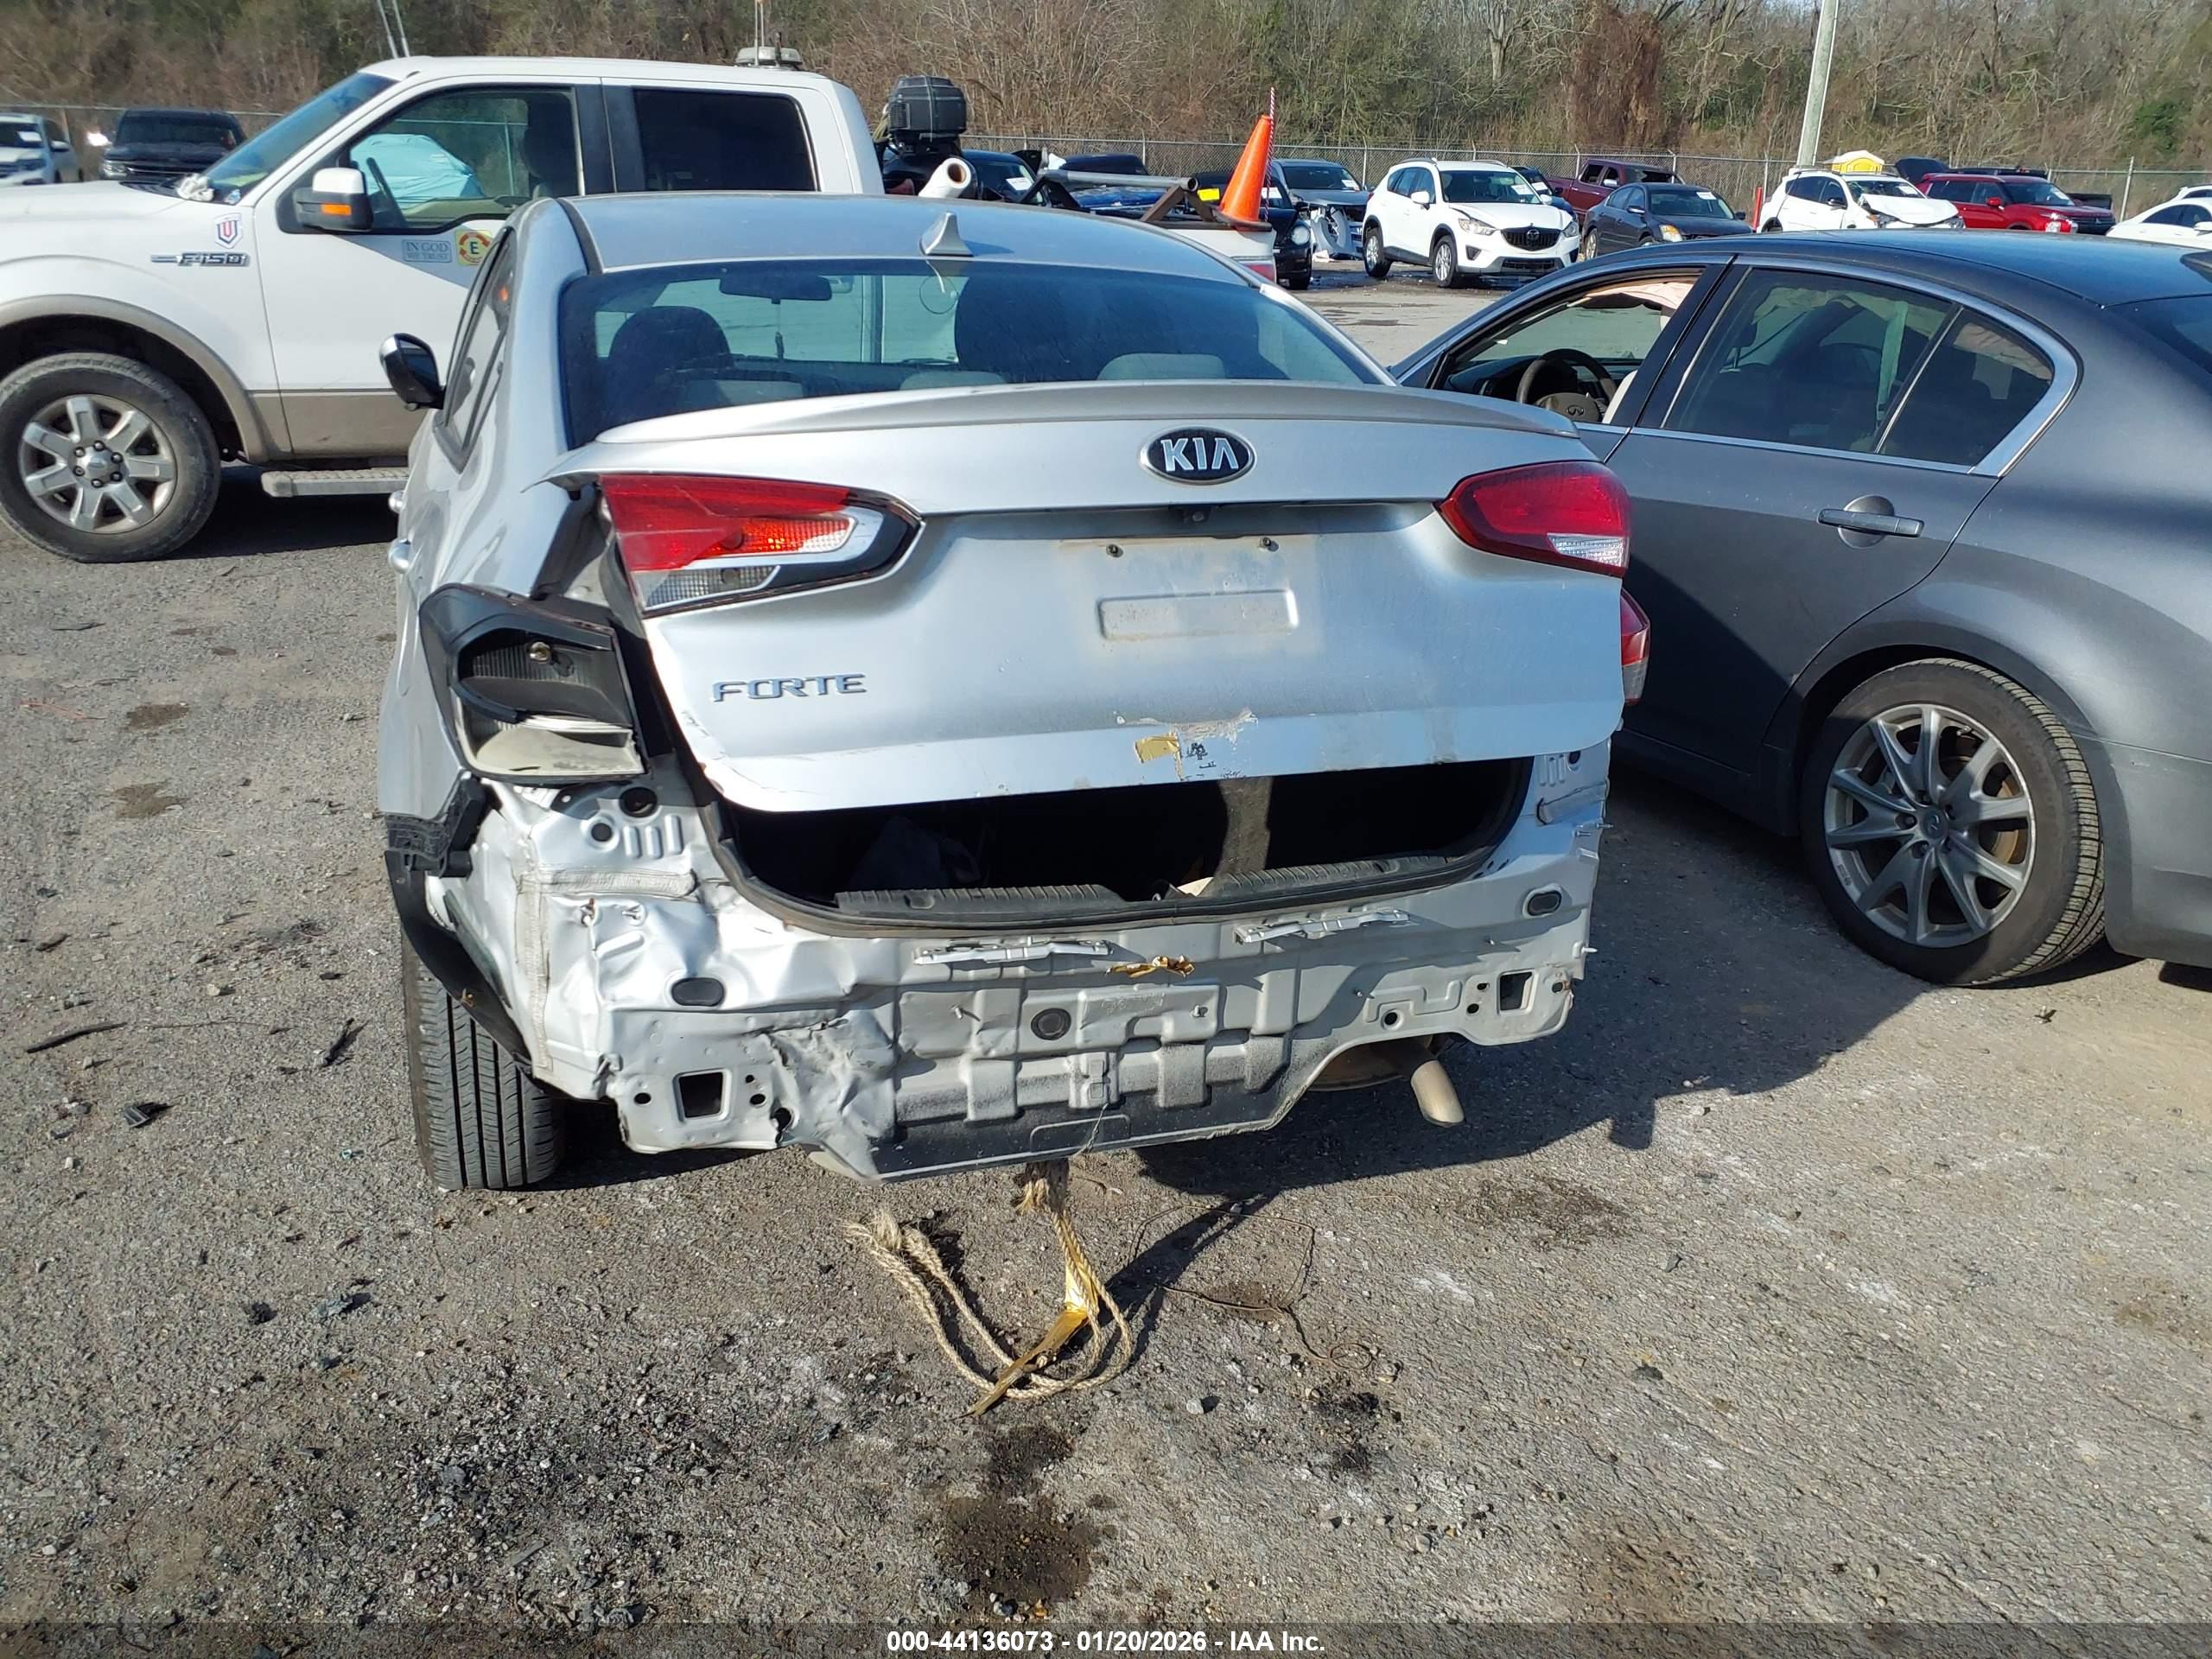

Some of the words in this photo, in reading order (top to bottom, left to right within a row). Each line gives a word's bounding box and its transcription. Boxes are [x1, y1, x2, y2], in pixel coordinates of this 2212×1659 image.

[421, 242, 448, 252] GOD
[470, 241, 480, 255] E
[1160, 437, 1239, 472] KIA
[712, 673, 867, 702] FORTE
